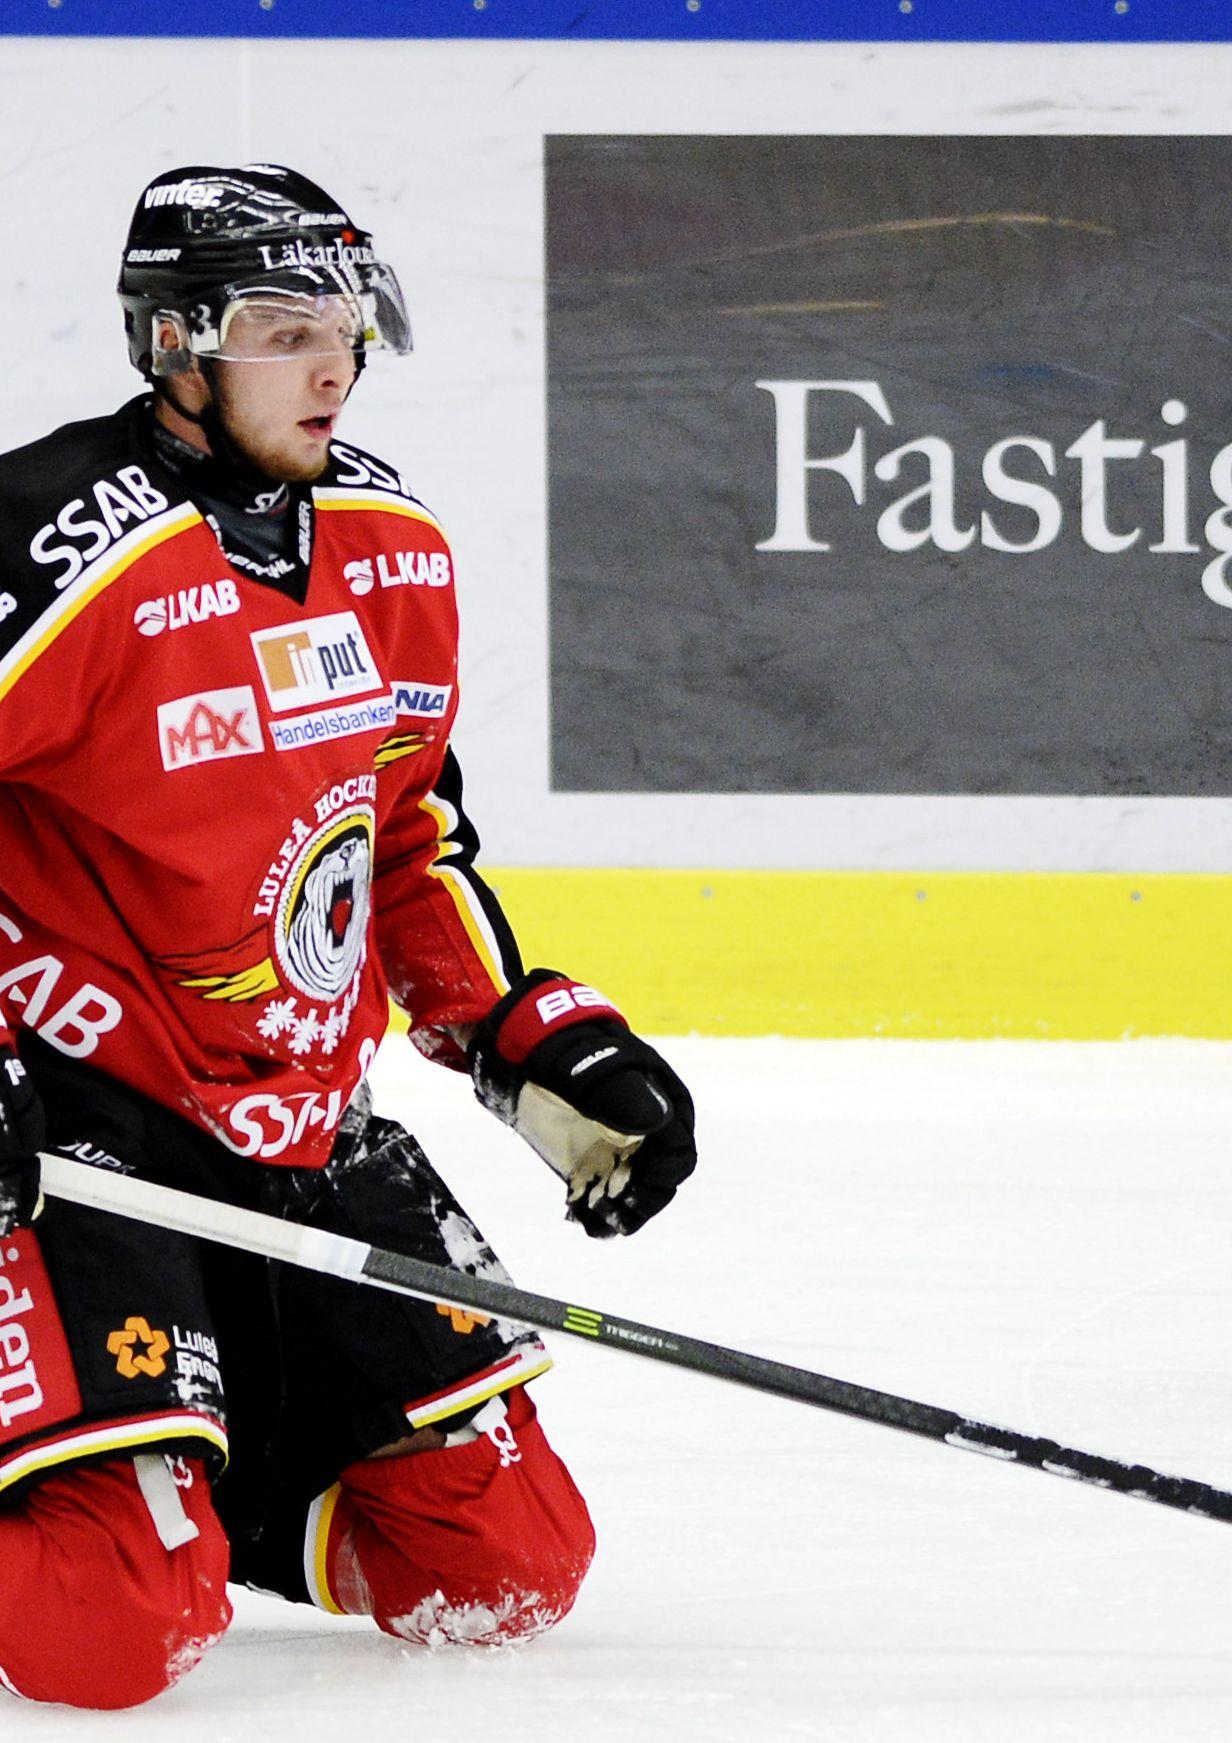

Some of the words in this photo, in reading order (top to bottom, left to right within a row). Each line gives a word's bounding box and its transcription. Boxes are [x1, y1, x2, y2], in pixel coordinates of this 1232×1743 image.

[30, 465, 168, 589] SSAB
[376, 551, 451, 589] LKAB
[167, 578, 242, 631] LKAB
[165, 701, 250, 762] MAX
[273, 703, 396, 746] Handelsbanken
[253, 817, 313, 916] LULEÅ
